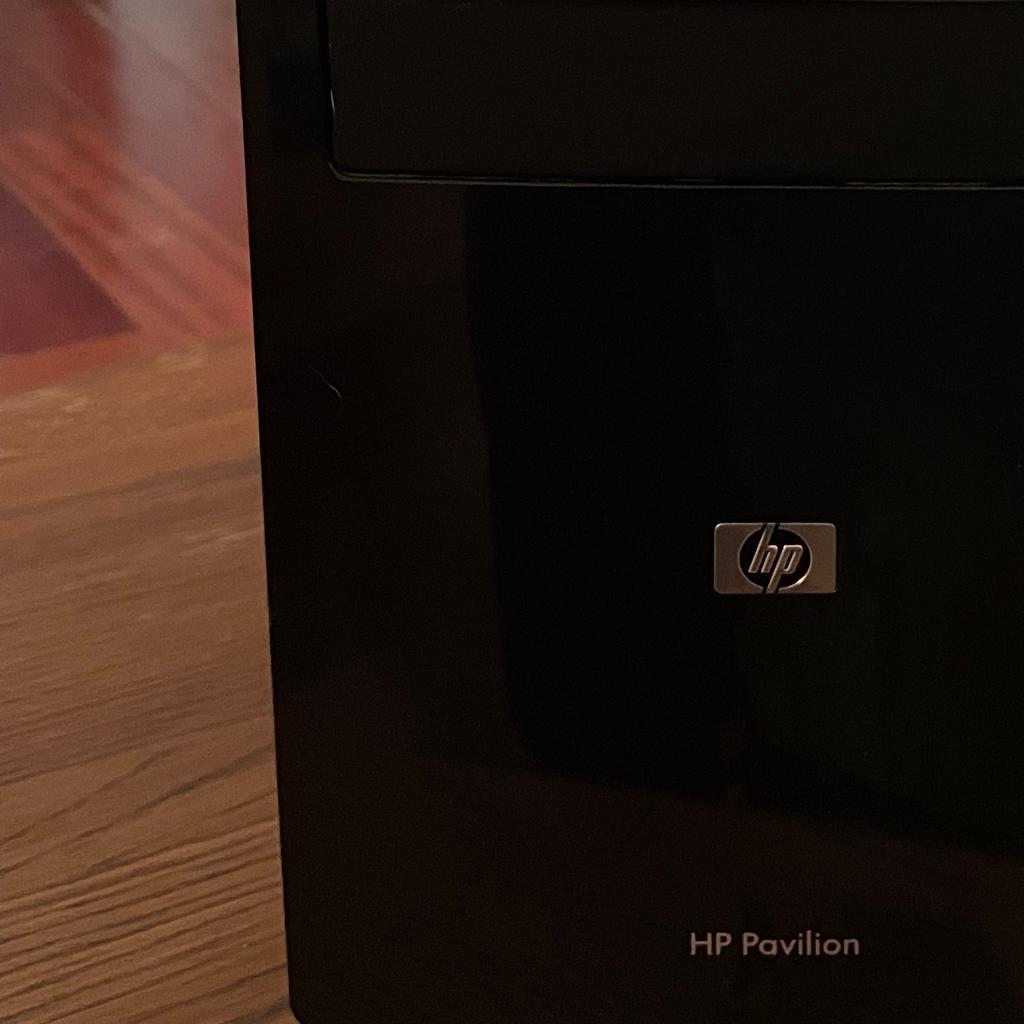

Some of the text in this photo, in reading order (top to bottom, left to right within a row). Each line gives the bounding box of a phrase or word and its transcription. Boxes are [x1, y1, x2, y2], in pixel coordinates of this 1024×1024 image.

[748, 522, 804, 595] hp
[690, 929, 860, 956] HP Pavilion
